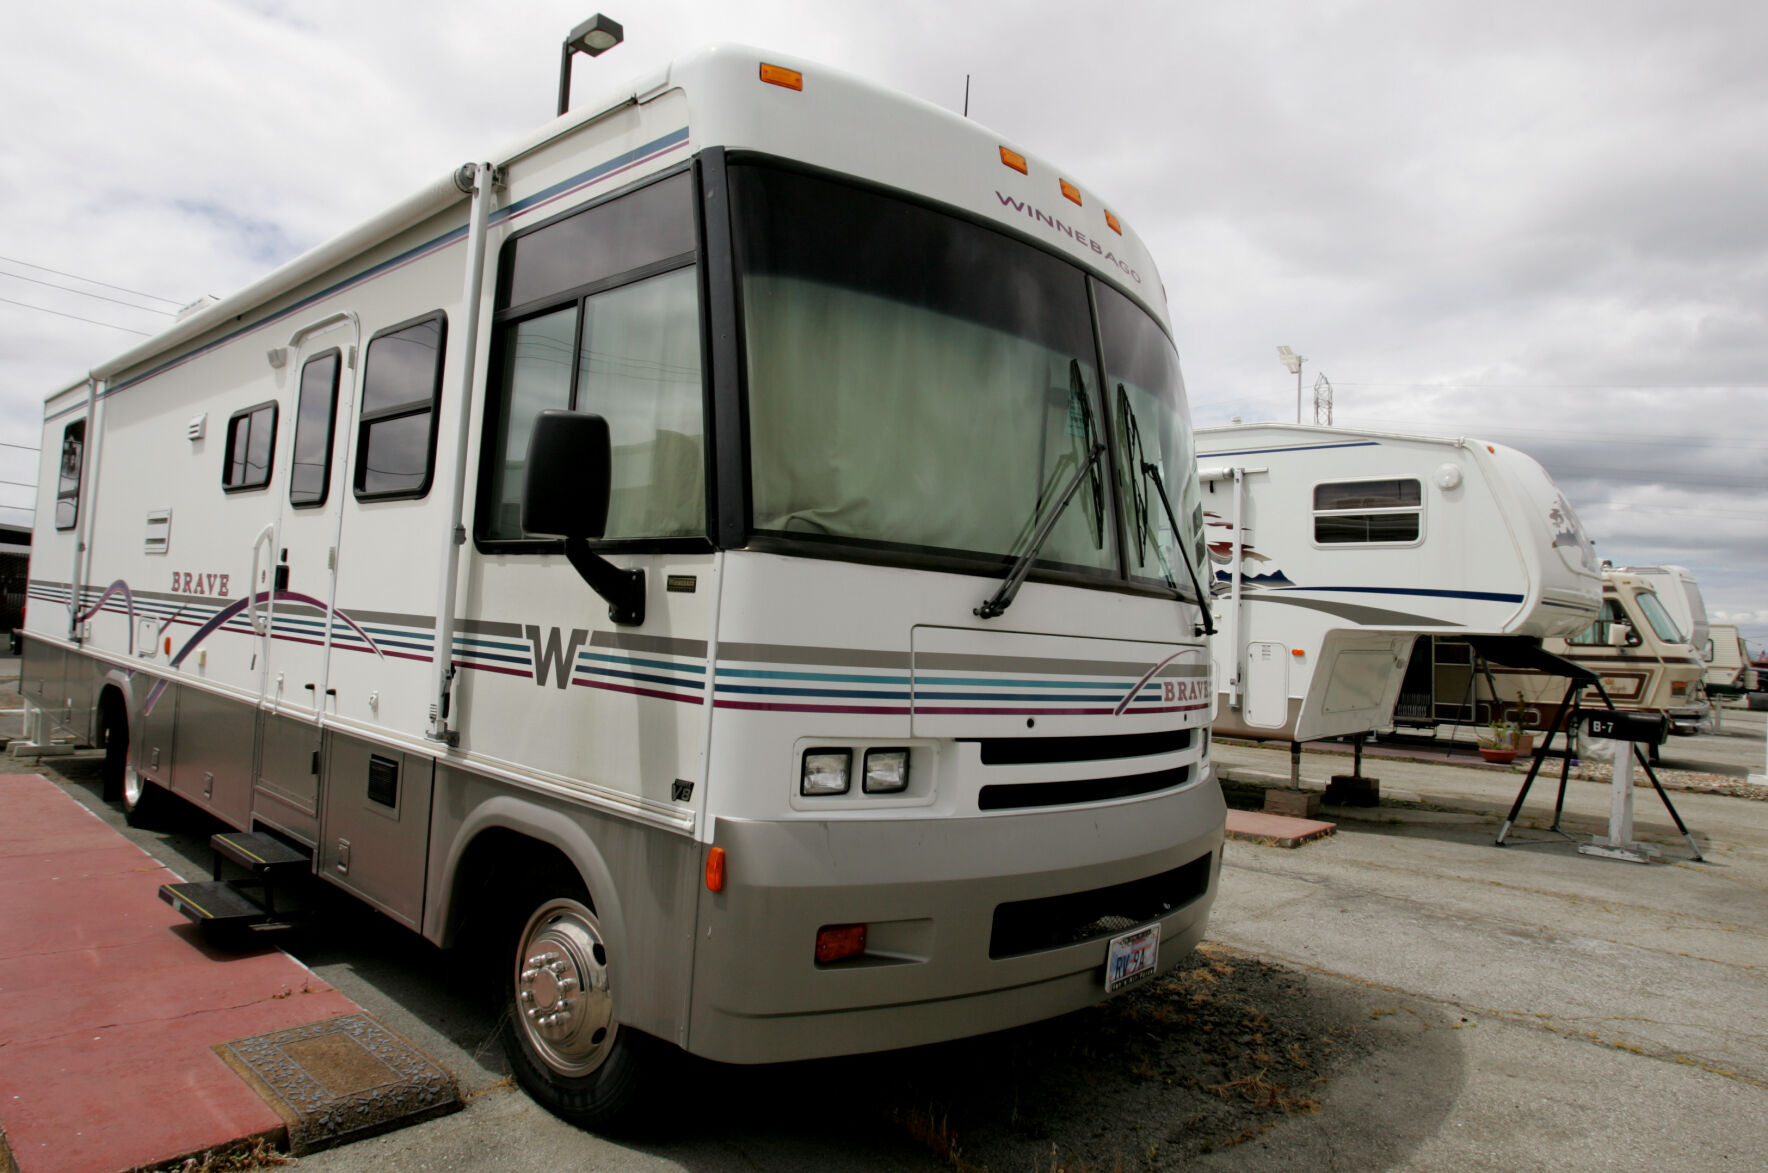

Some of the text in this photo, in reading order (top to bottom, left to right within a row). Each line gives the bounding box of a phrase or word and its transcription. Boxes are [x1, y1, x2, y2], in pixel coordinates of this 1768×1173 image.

[995, 190, 1142, 284] WINNEBAGO
[171, 571, 230, 597] BRAVE
[525, 624, 589, 690] W
[1163, 680, 1209, 702] BRAVE
[1593, 720, 1615, 734] B-7
[671, 782, 692, 802] V8
